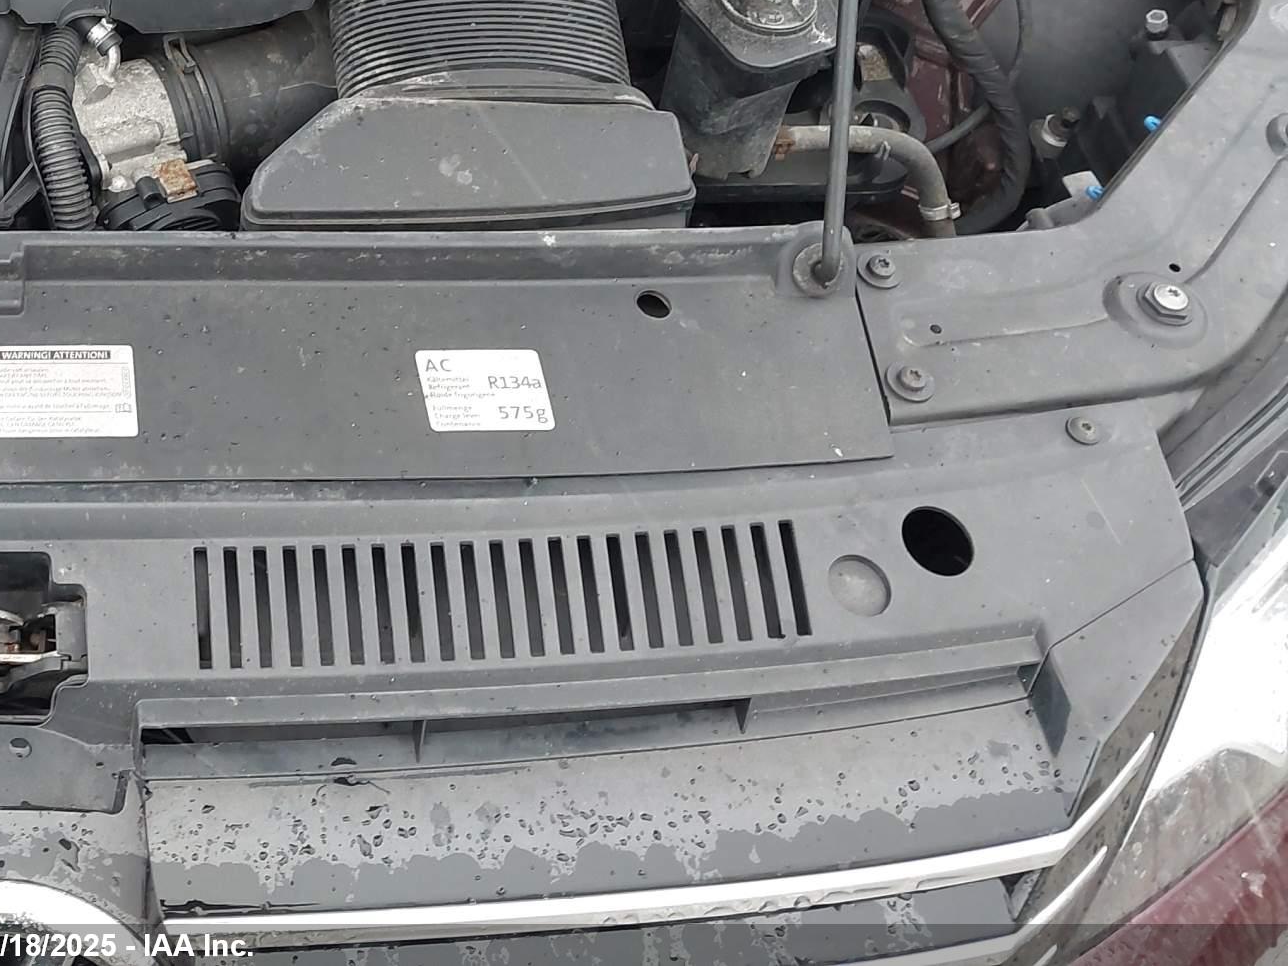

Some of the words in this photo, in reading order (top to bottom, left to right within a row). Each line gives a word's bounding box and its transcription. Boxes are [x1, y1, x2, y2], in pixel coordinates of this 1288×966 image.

[1, 351, 51, 360] WARNING!
[53, 350, 108, 359] ATTENTION!
[487, 375, 542, 390] R134a
[498, 405, 548, 424] 575g
